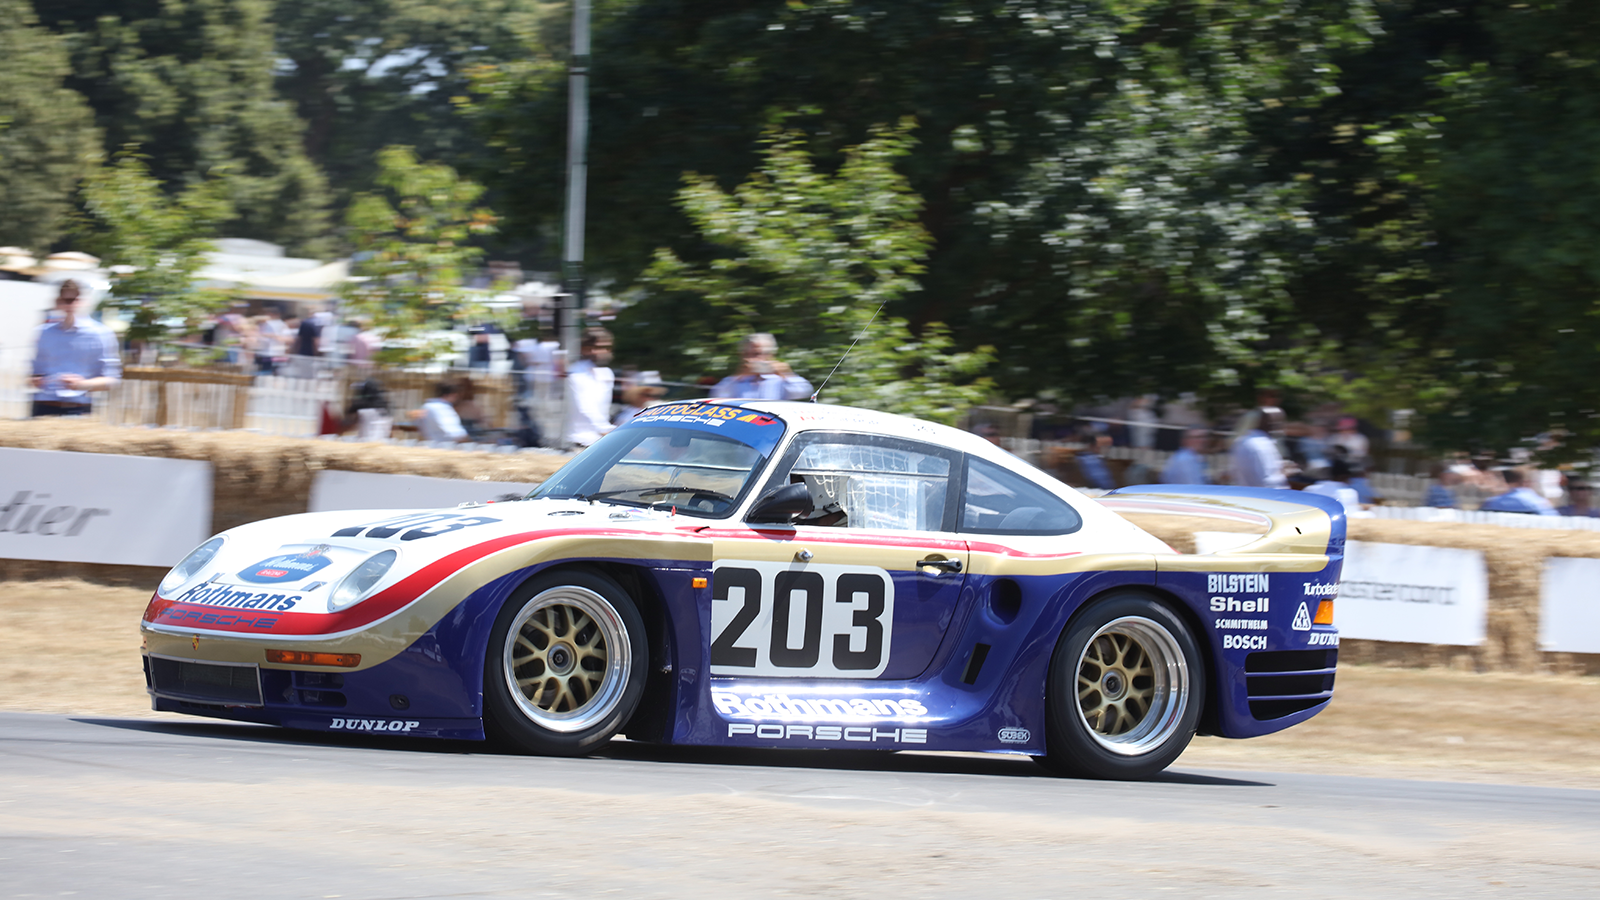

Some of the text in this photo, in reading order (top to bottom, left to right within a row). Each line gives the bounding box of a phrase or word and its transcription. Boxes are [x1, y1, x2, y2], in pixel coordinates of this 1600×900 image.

[641, 404, 742, 420] AUTOGLASS
[0, 490, 111, 536] tier
[1208, 574, 1270, 593] BILSTEIN
[1303, 582, 1340, 596] Turbolade
[176, 582, 302, 611] Rothmans
[1209, 596, 1270, 612] Shell
[158, 607, 278, 629] PORSCHE
[710, 566, 885, 670] 203
[1223, 634, 1268, 650] BOSCH
[711, 692, 928, 716] Rothmans
[329, 718, 420, 732] DUNLOP
[727, 723, 928, 744] PORSCHE
